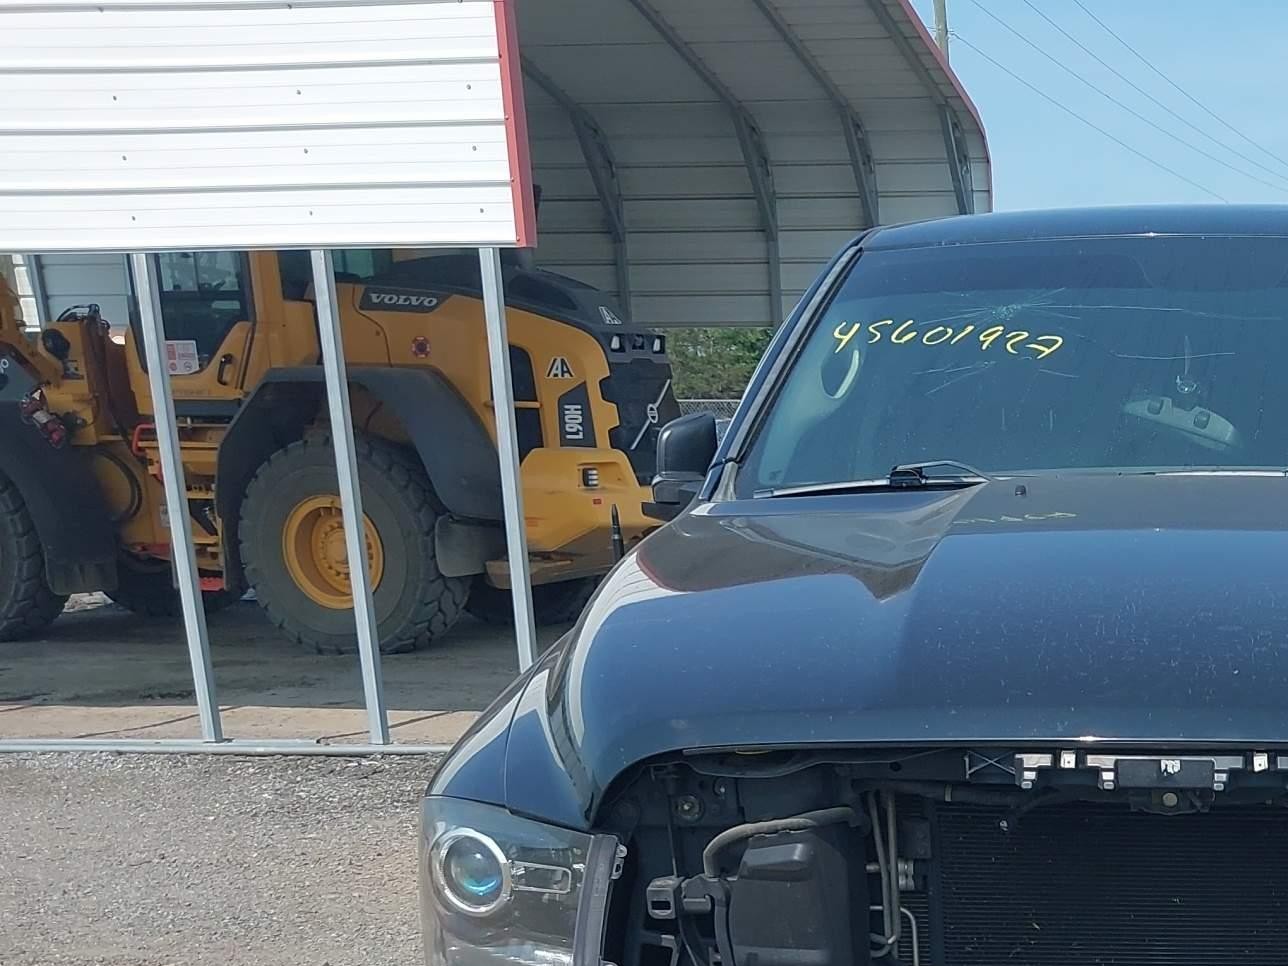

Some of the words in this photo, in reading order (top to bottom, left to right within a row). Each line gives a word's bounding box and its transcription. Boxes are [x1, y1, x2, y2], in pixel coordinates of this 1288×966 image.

[369, 293, 438, 307] VOLVO
[832, 319, 1065, 360] 45601927
[563, 404, 583, 440] L90H
